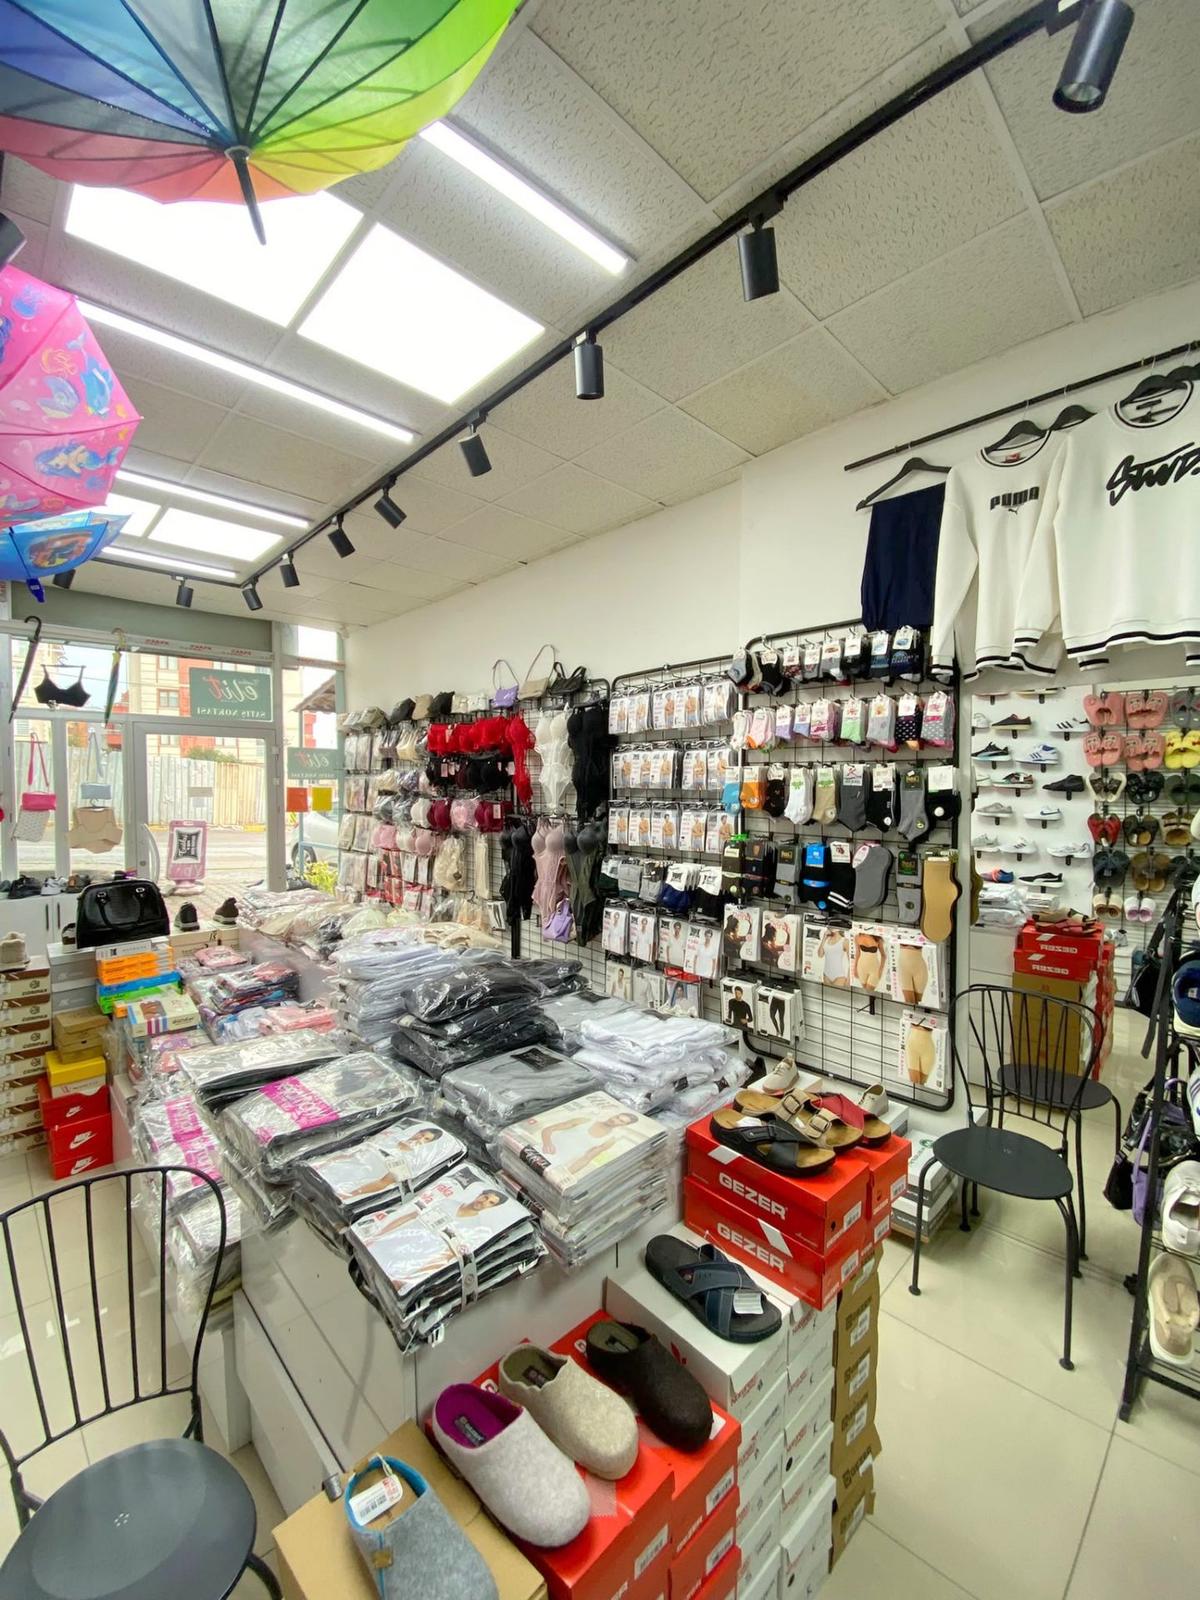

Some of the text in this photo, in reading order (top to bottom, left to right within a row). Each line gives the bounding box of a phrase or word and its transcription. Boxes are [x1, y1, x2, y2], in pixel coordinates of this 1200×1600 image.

[990, 486, 1040, 511] PUMA
[719, 1172, 786, 1220] GEZER
[717, 1222, 785, 1273] GEZER
